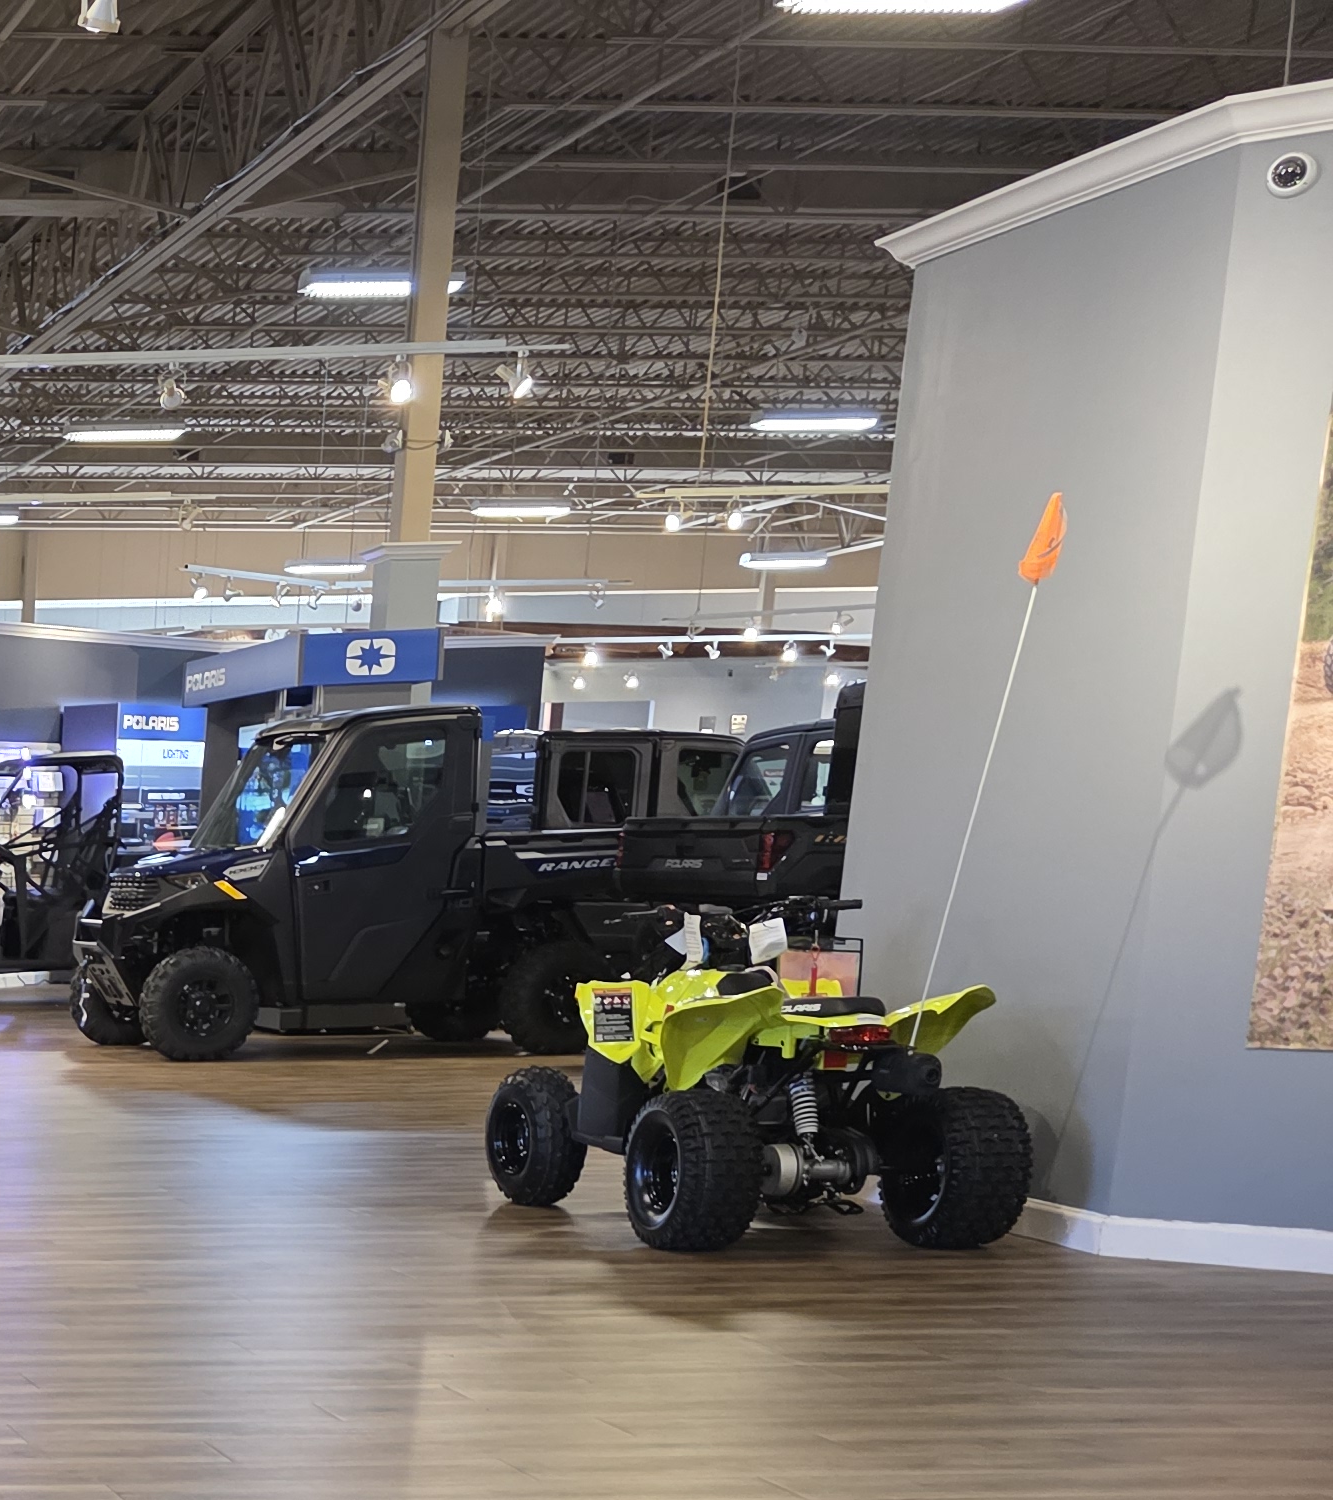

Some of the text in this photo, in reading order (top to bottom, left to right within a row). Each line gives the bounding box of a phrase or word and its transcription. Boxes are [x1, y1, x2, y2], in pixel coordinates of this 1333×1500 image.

[186, 668, 226, 693] POLARIS
[123, 714, 180, 732] POLARIS
[538, 857, 616, 873] RANGE
[665, 858, 703, 869] POLARIS
[781, 1003, 822, 1013] OLARIS
